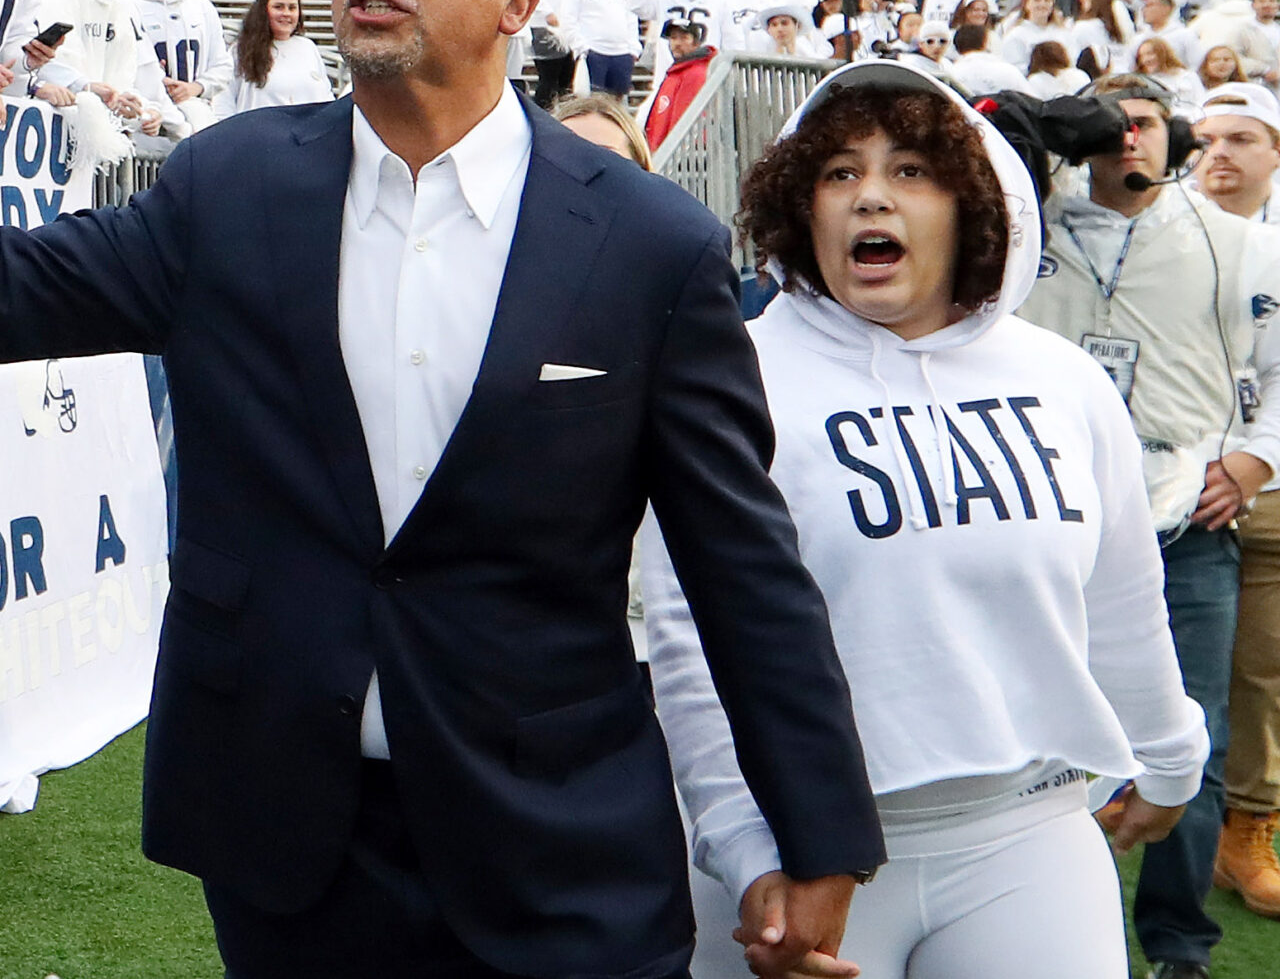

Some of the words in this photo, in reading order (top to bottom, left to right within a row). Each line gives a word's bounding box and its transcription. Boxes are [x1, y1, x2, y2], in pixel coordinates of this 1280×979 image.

[1089, 342, 1130, 360] OPERATIONS
[824, 396, 1084, 539] STATE
[95, 494, 126, 573] A
